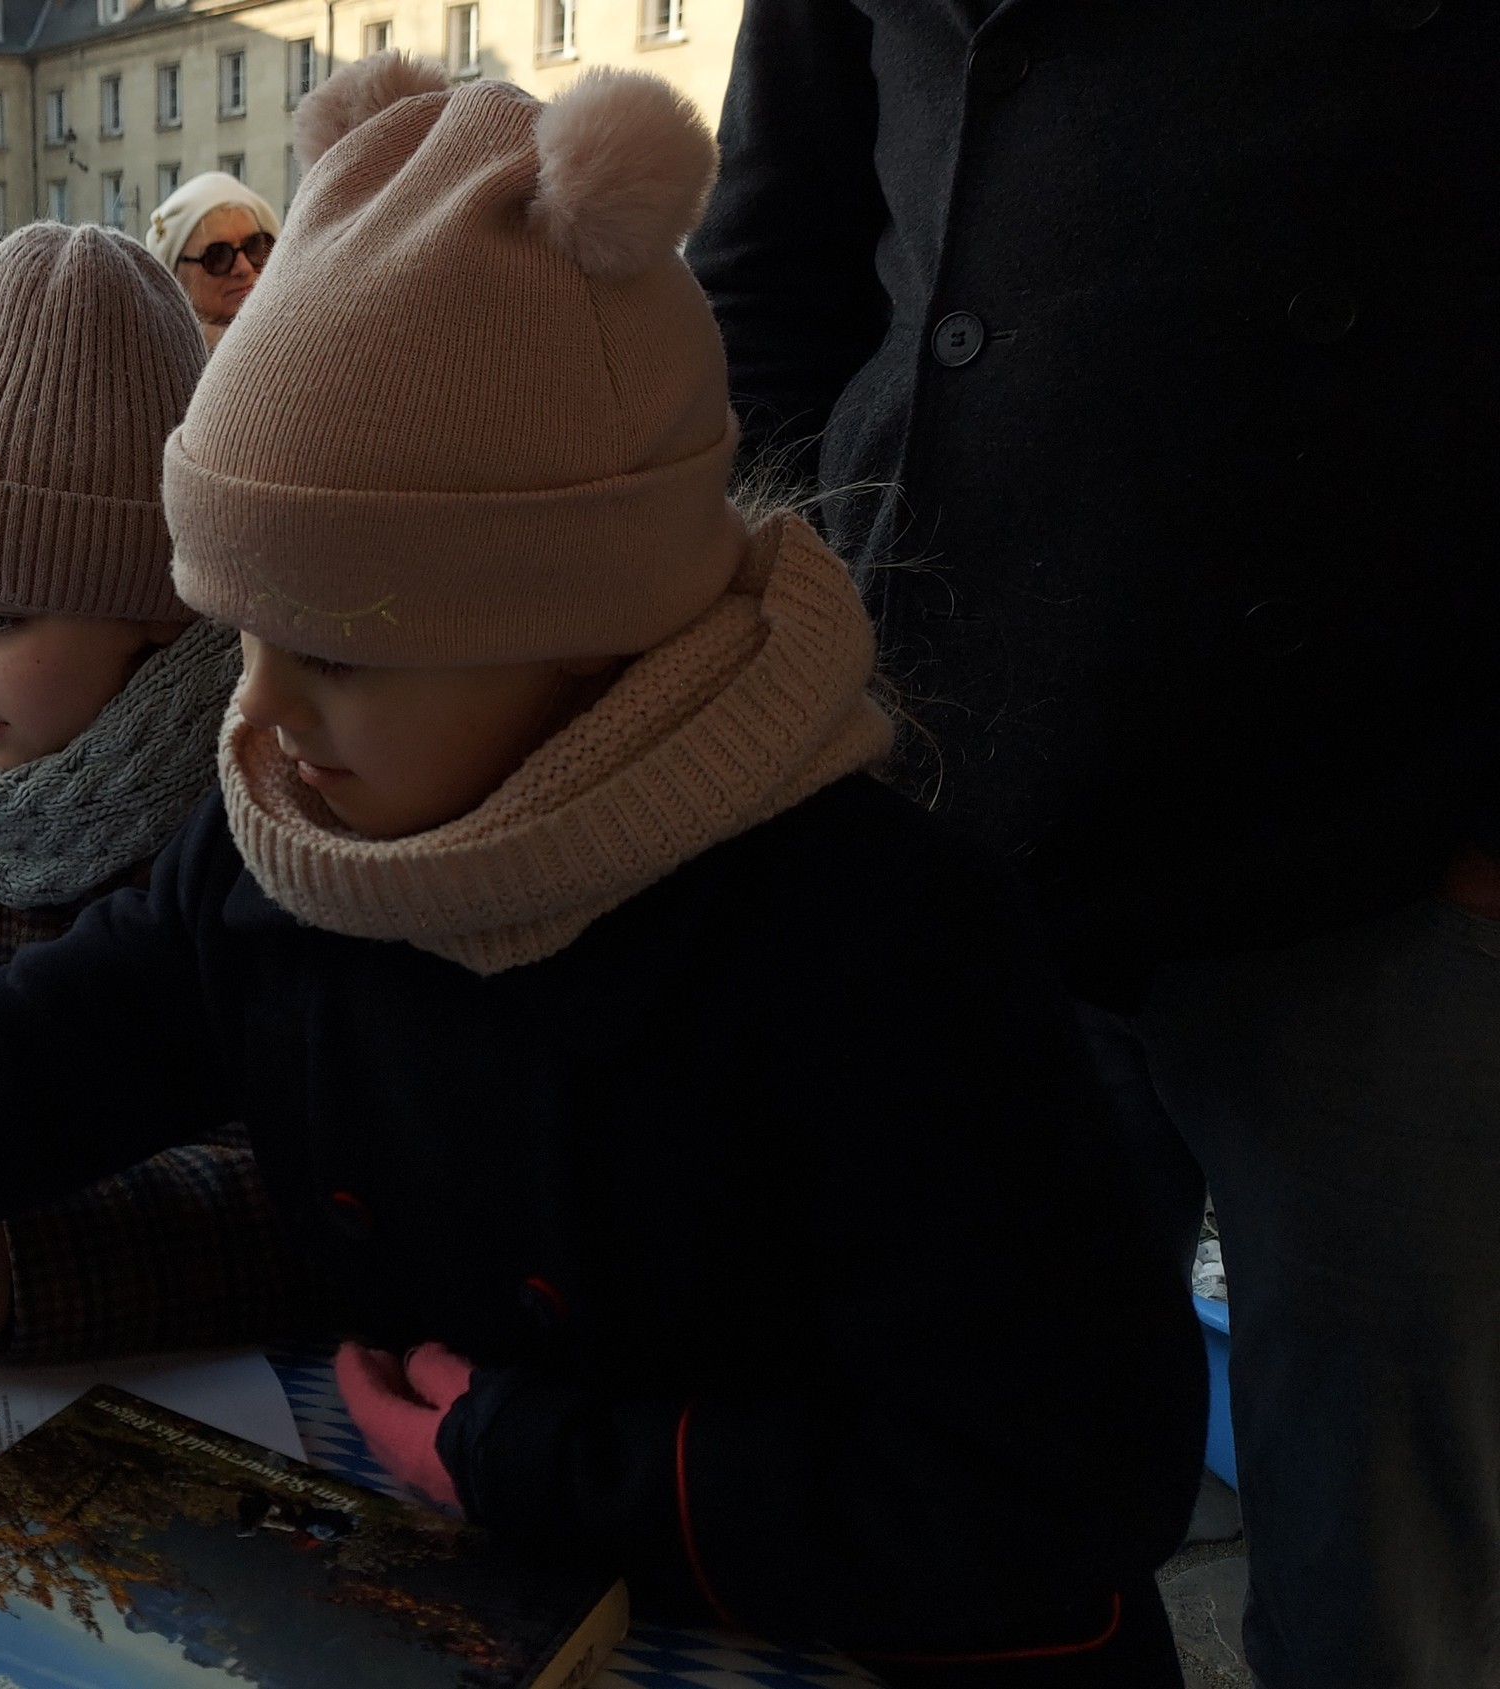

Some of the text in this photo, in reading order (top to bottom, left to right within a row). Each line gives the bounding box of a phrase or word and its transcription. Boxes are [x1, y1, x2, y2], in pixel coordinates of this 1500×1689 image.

[92, 1400, 157, 1431] Rügen
[153, 1422, 185, 1443] bis
[175, 1434, 313, 1493] Schwarzwald
